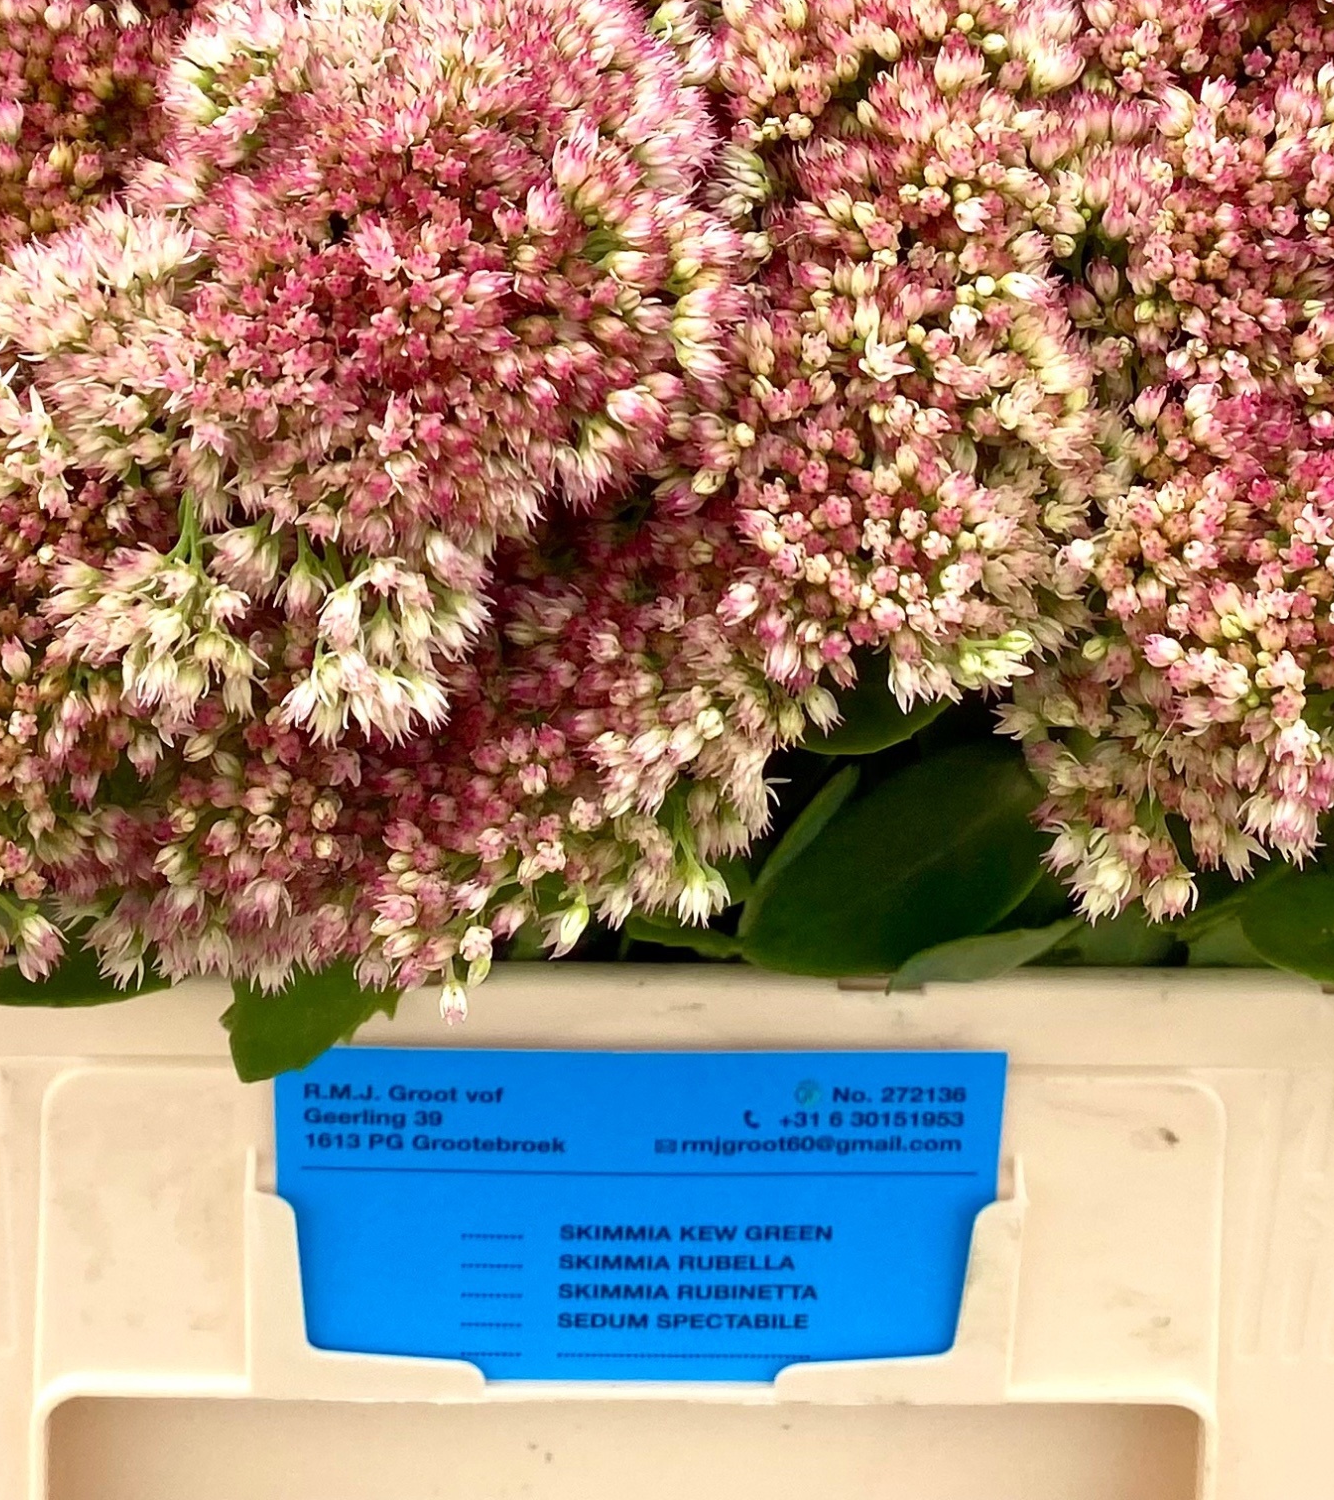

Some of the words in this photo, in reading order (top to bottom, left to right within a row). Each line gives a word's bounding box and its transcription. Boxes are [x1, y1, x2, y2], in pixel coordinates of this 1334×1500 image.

[303, 1083, 380, 1101] R.M.J.
[388, 1084, 457, 1103] Groot
[466, 1087, 504, 1104] vof
[832, 1087, 873, 1104] No.
[881, 1086, 967, 1104] 272136
[303, 1107, 406, 1130] Geerling
[413, 1110, 444, 1127] 39
[779, 1111, 820, 1128] +31
[829, 1111, 844, 1128] 6
[850, 1110, 965, 1128] 30151953
[305, 1132, 361, 1150] 1613
[369, 1133, 404, 1151] PG
[412, 1134, 566, 1154] Grootebroek
[559, 1224, 672, 1242] SKIMMIA
[680, 1225, 738, 1242] KEW
[745, 1225, 834, 1243] GREEN
[559, 1254, 671, 1271] SKIMMIA
[679, 1255, 796, 1272] RUBELLA
[558, 1284, 670, 1301] SKIMMIA
[678, 1284, 819, 1301] RUBINETTA
[557, 1313, 649, 1330] SEDUM
[656, 1313, 809, 1330] SPECTABILE
